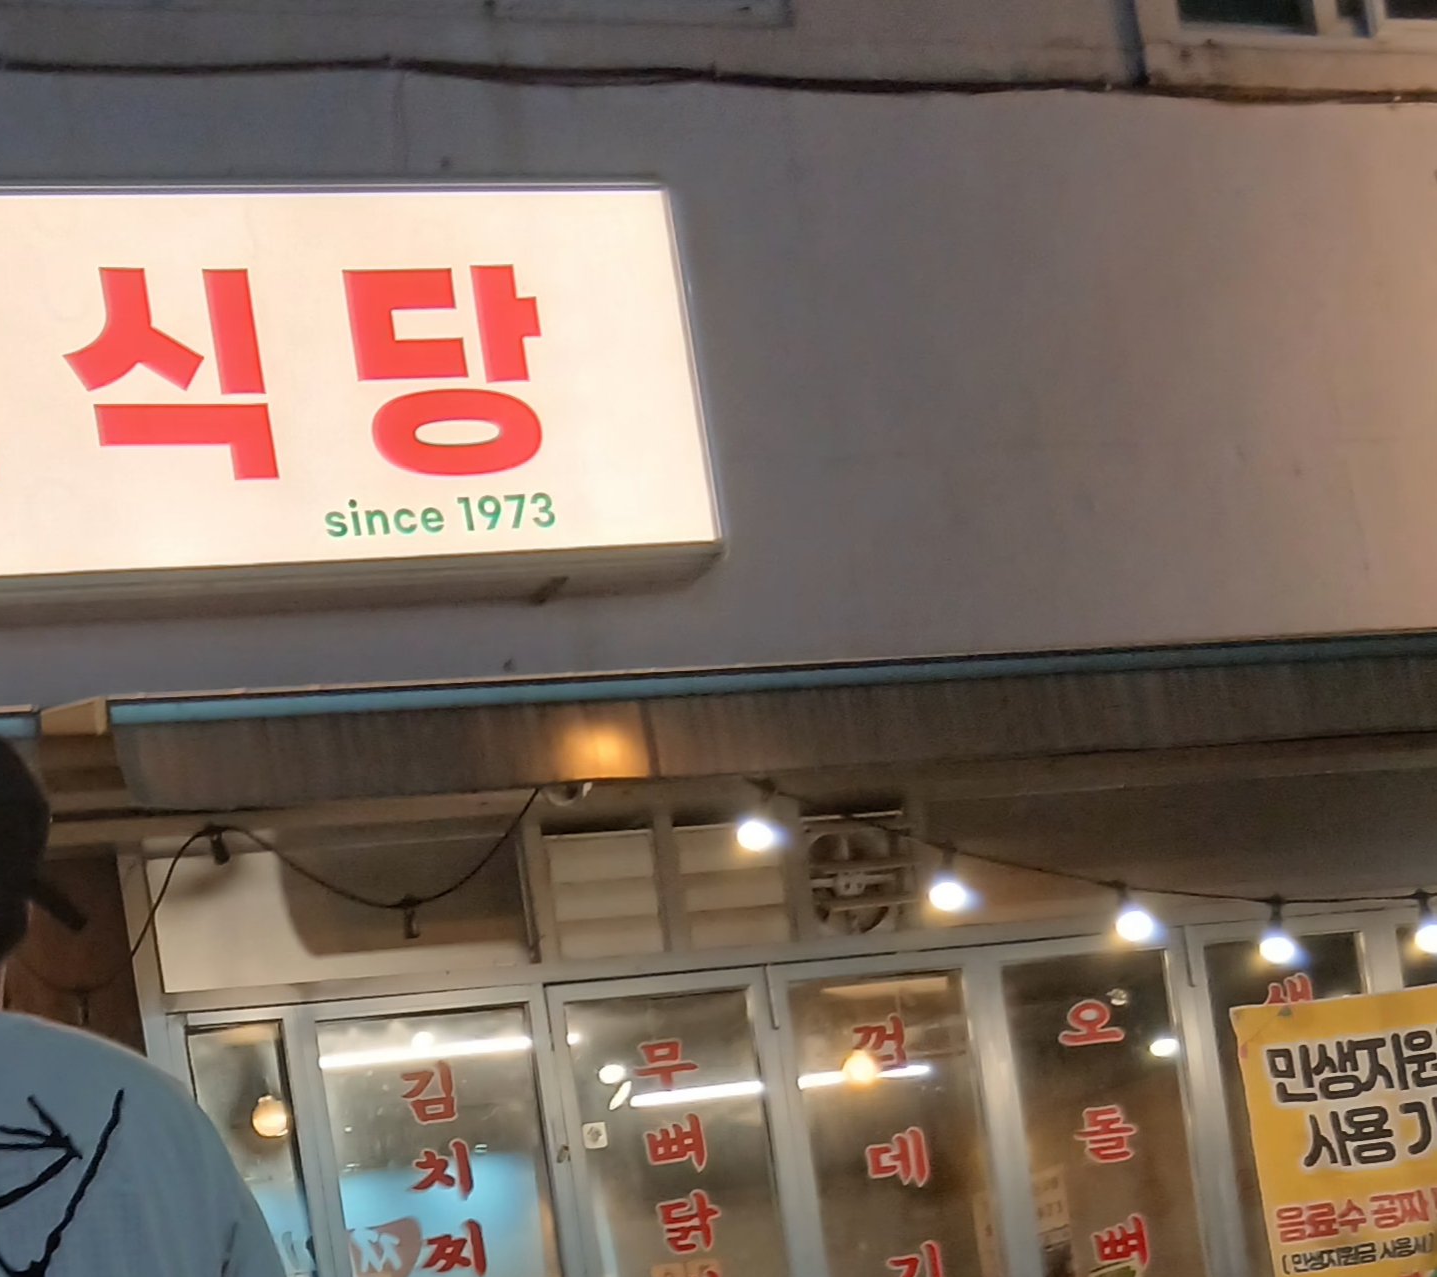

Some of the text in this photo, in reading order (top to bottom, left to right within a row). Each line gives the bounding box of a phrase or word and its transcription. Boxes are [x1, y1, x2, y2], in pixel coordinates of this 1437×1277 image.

[324, 491, 556, 537] since 1973
[1304, 1105, 1396, 1167] 사용
[1276, 1189, 1429, 1242] 음료수 공짜
